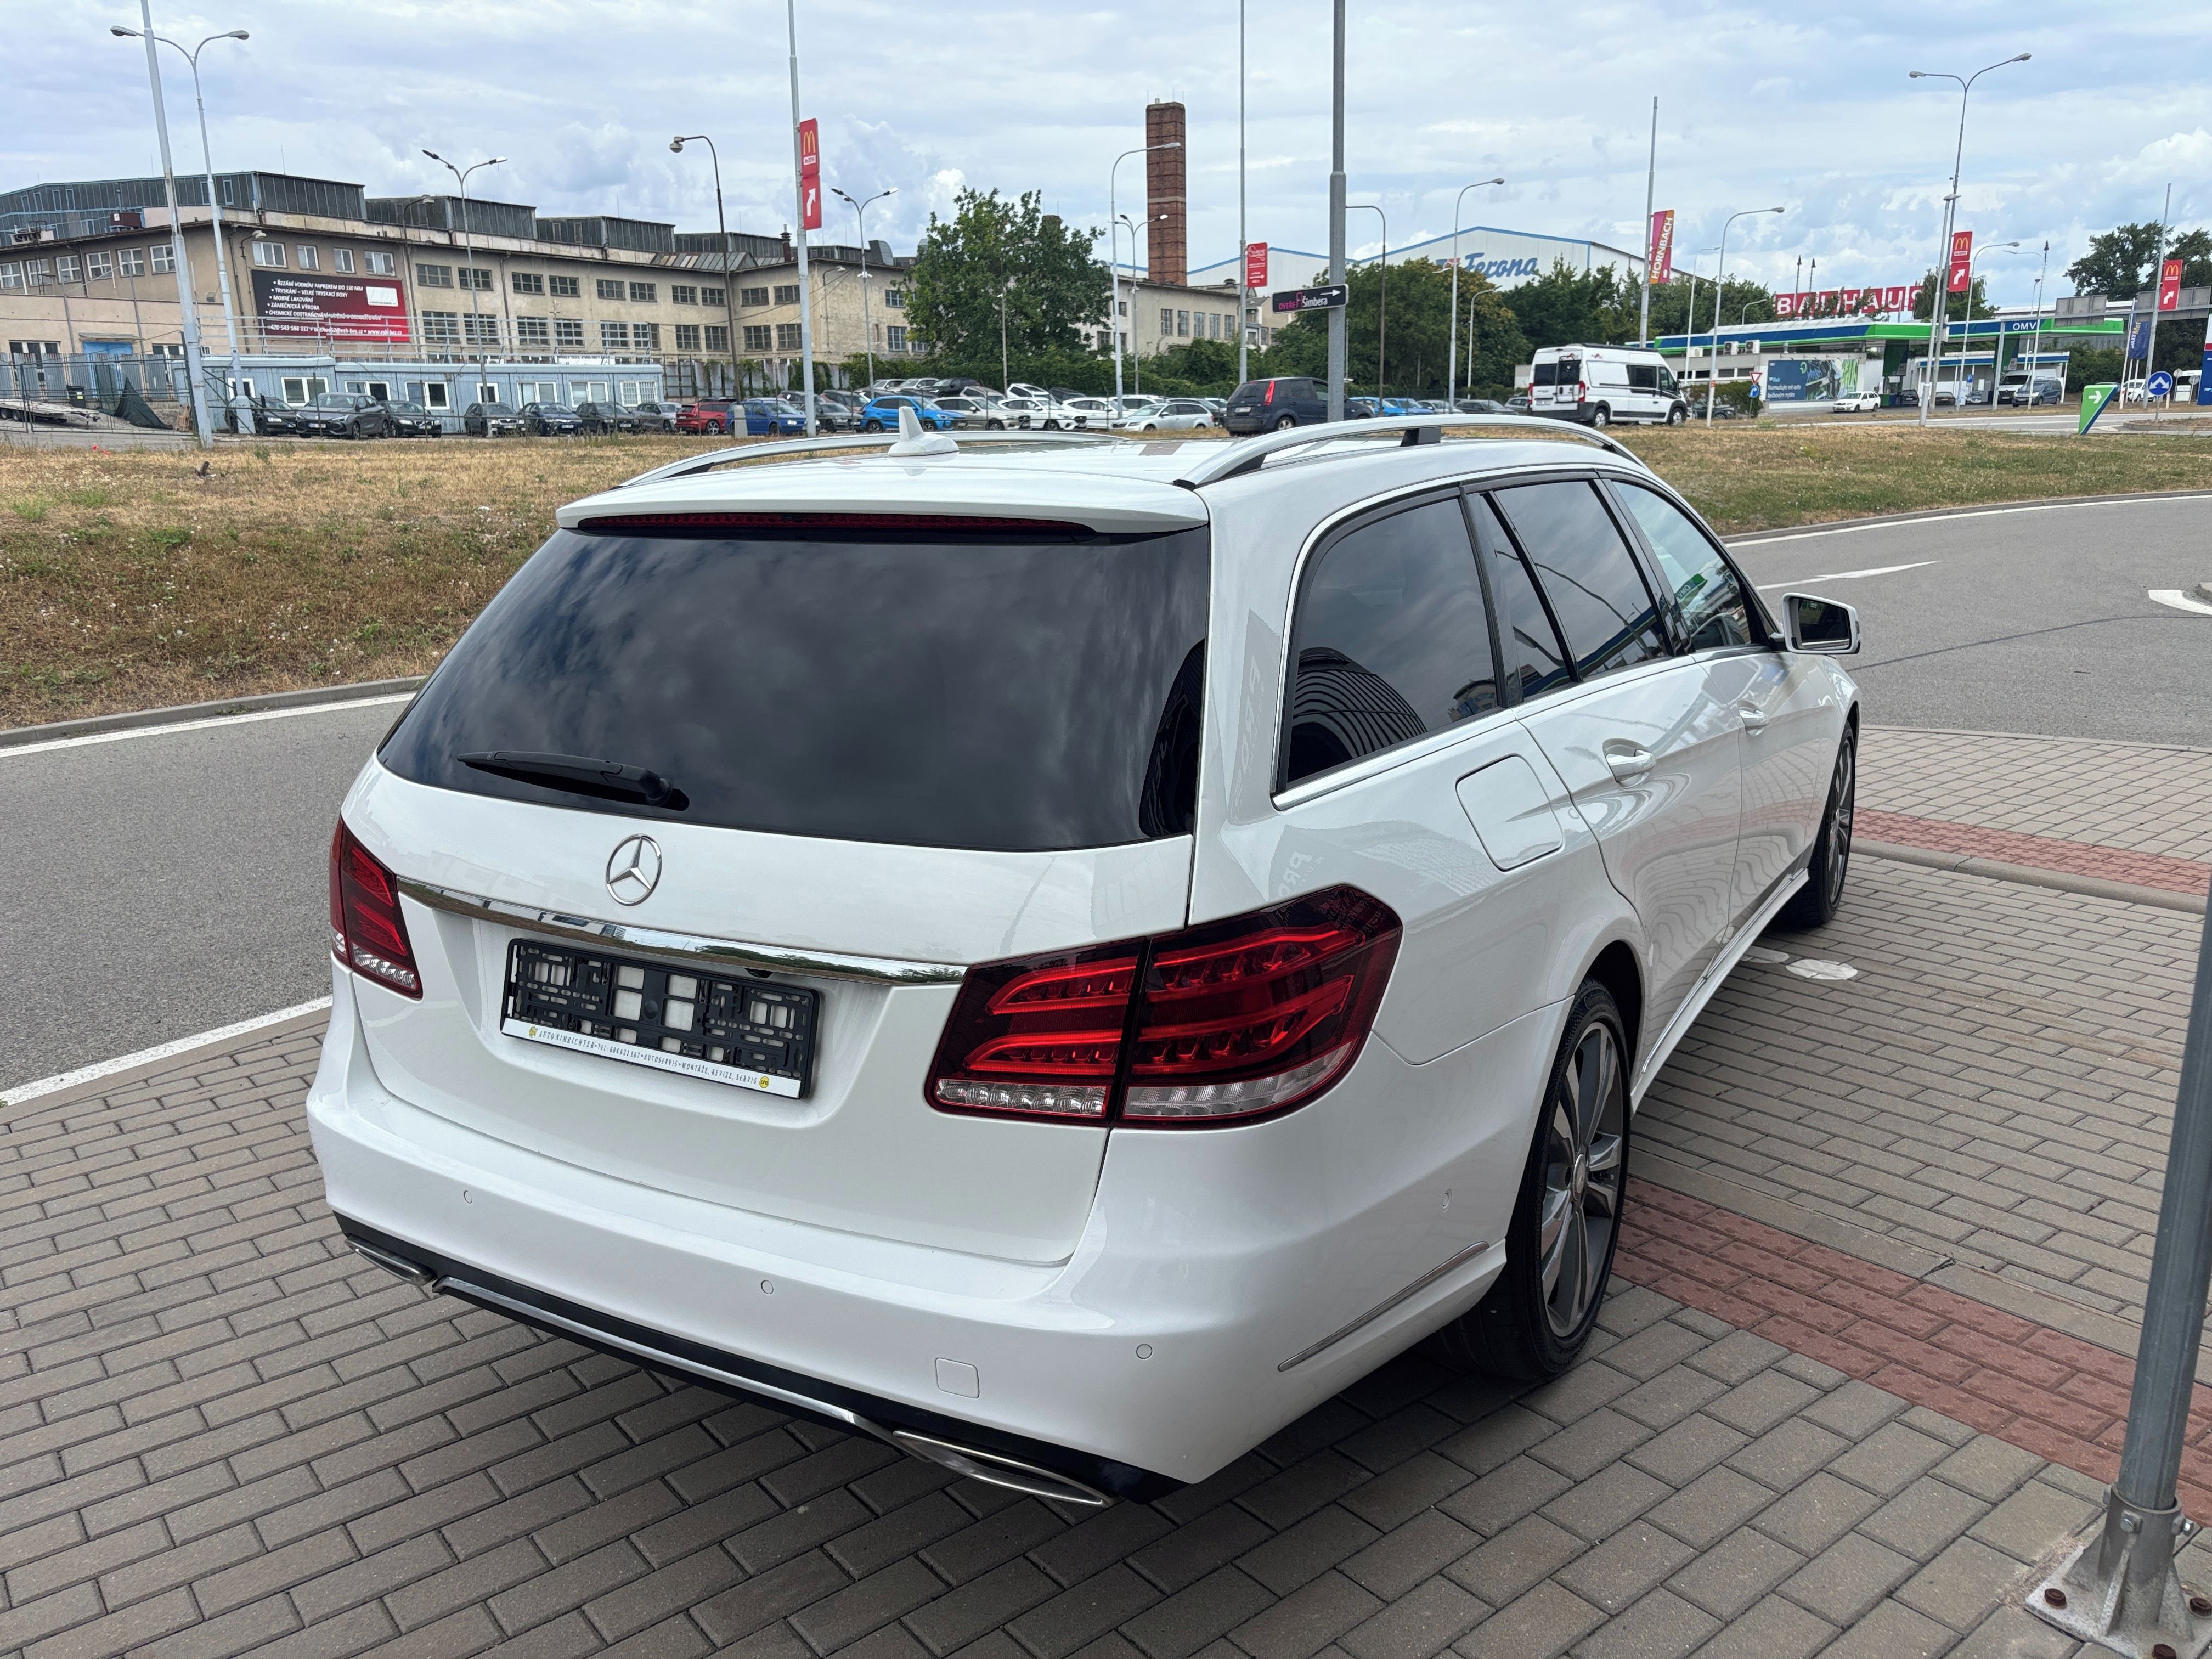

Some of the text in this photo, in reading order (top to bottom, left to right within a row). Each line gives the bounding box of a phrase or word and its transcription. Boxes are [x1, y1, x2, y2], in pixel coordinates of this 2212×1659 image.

[1650, 217, 1673, 279] HORNBACH
[1465, 252, 1538, 278] Ferona
[1278, 296, 1328, 310] DVEŘE Šimbera
[2013, 322, 2037, 331] OMV
[610, 1046, 619, 1054] 604
[620, 1048, 629, 1056] 622
[630, 1050, 640, 1058] 107
[644, 1053, 677, 1066] AUTOSERVIS
[681, 1060, 709, 1074] MONTÁŽE,
[712, 1068, 733, 1080] REVIZE,
[736, 1074, 757, 1084] SERVIS
